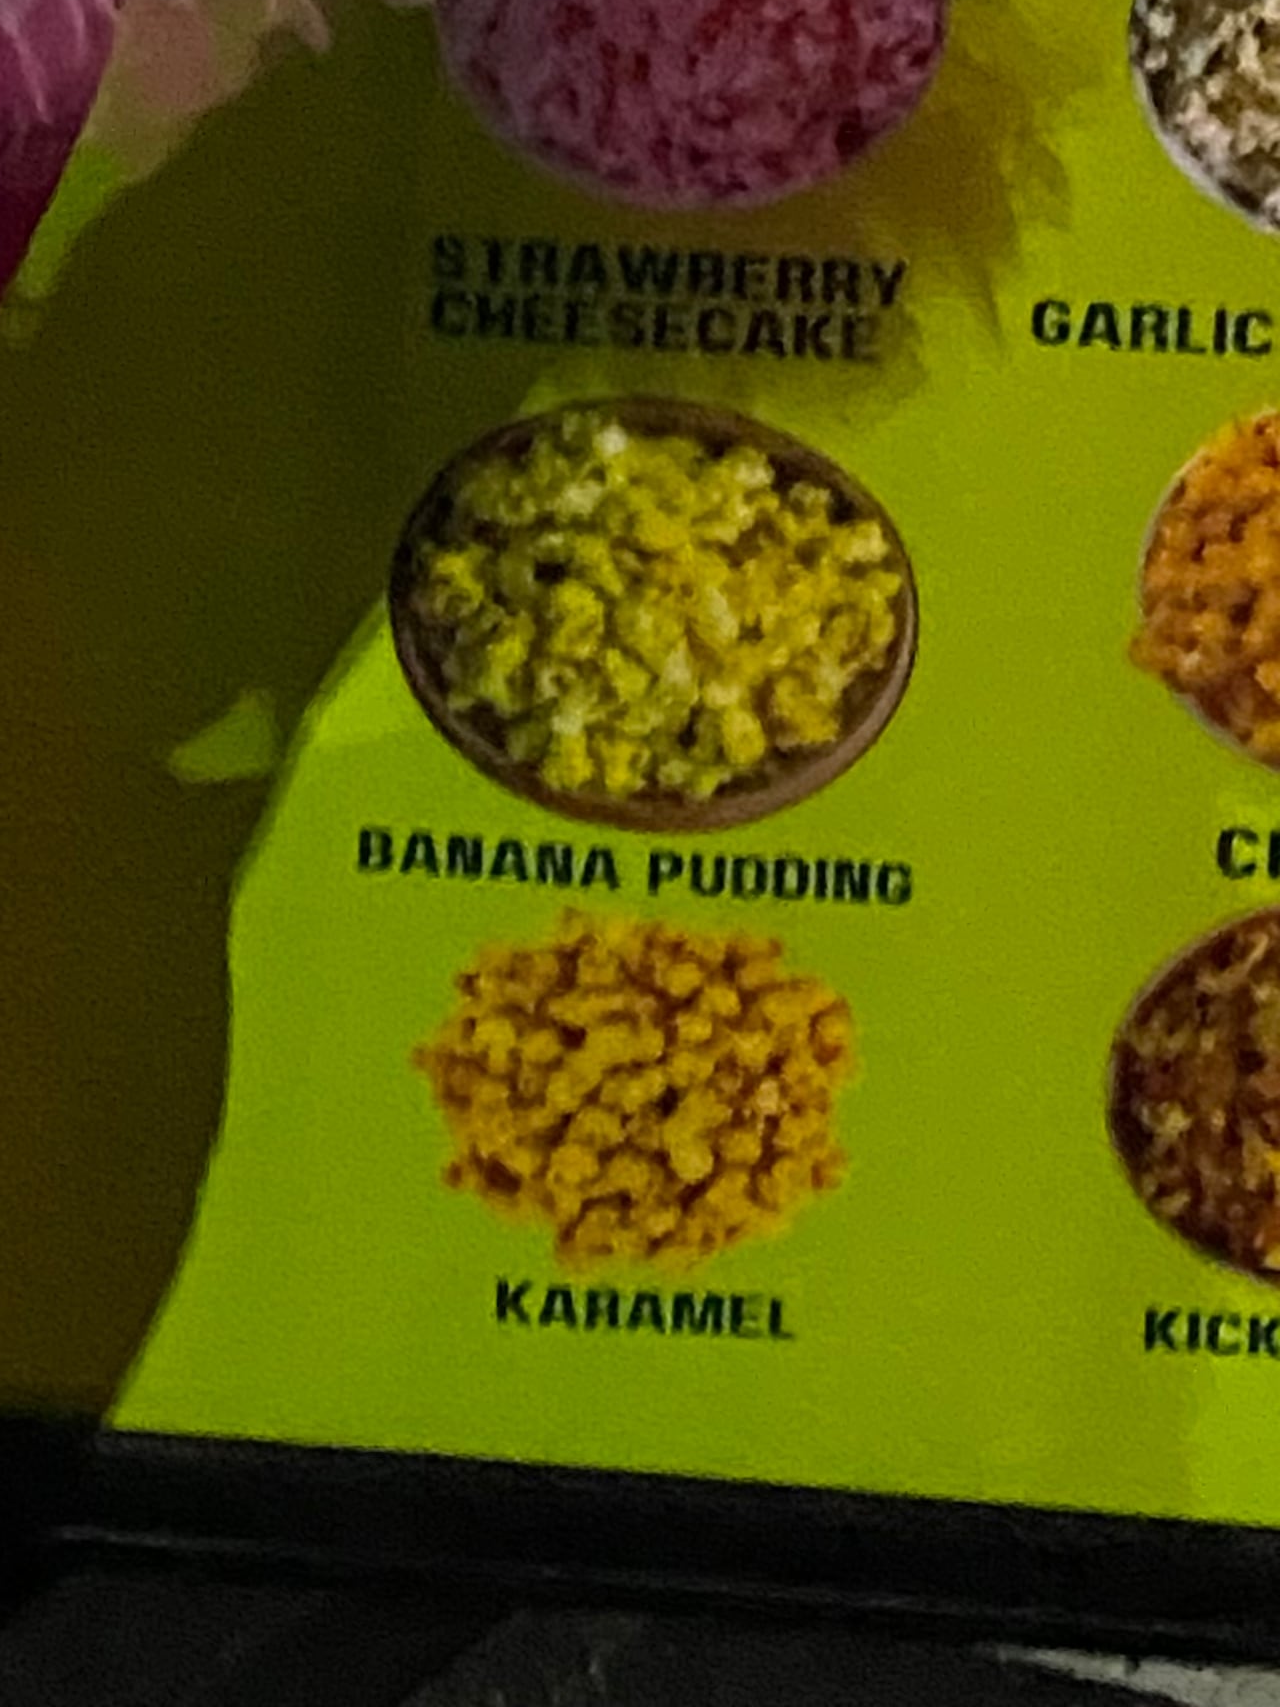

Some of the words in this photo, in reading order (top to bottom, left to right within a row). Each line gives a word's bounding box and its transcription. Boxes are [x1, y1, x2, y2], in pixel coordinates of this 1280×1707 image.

[433, 234, 907, 308] STRAWBERRY
[431, 289, 882, 362] CHEESECAKE
[1031, 299, 1274, 357] GARLIC
[356, 826, 622, 892] BANANA
[647, 850, 913, 906] PUDDING
[495, 1275, 795, 1341] KARAMEL
